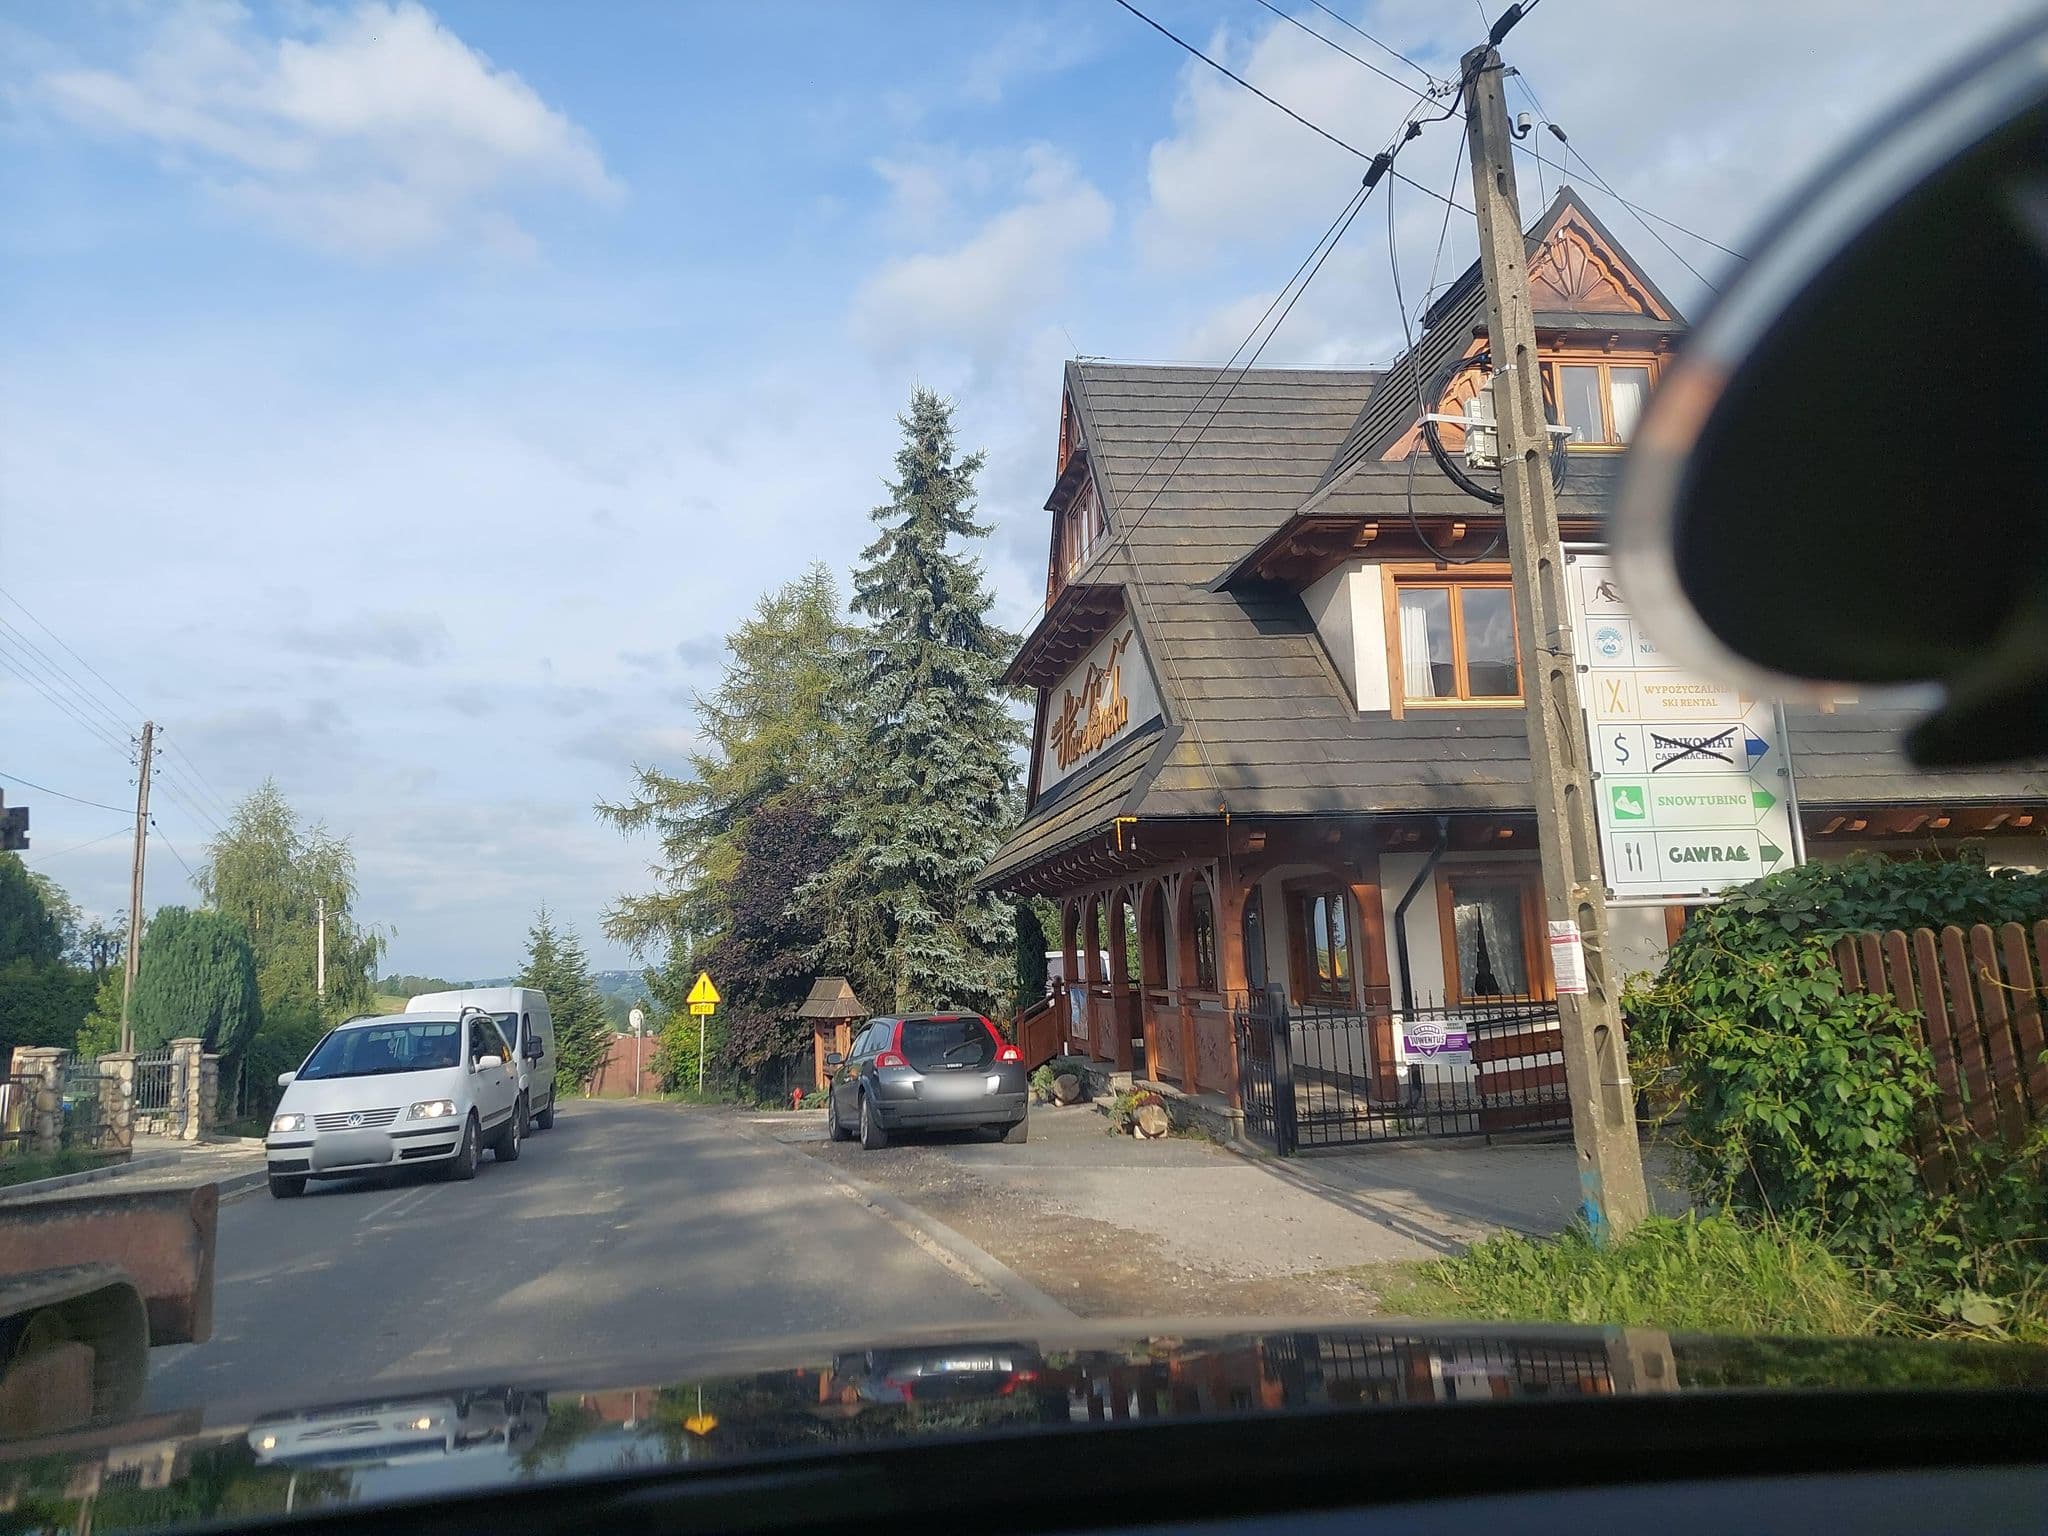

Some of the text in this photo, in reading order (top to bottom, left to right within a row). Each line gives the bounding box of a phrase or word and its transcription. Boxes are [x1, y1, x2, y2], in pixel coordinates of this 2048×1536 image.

[1663, 698, 1718, 708] SKI RENTAL
[1654, 737, 1734, 749] BANKOMAT
[1658, 795, 1747, 806] SNOWTUBING
[1669, 846, 1735, 863] GAWRA
